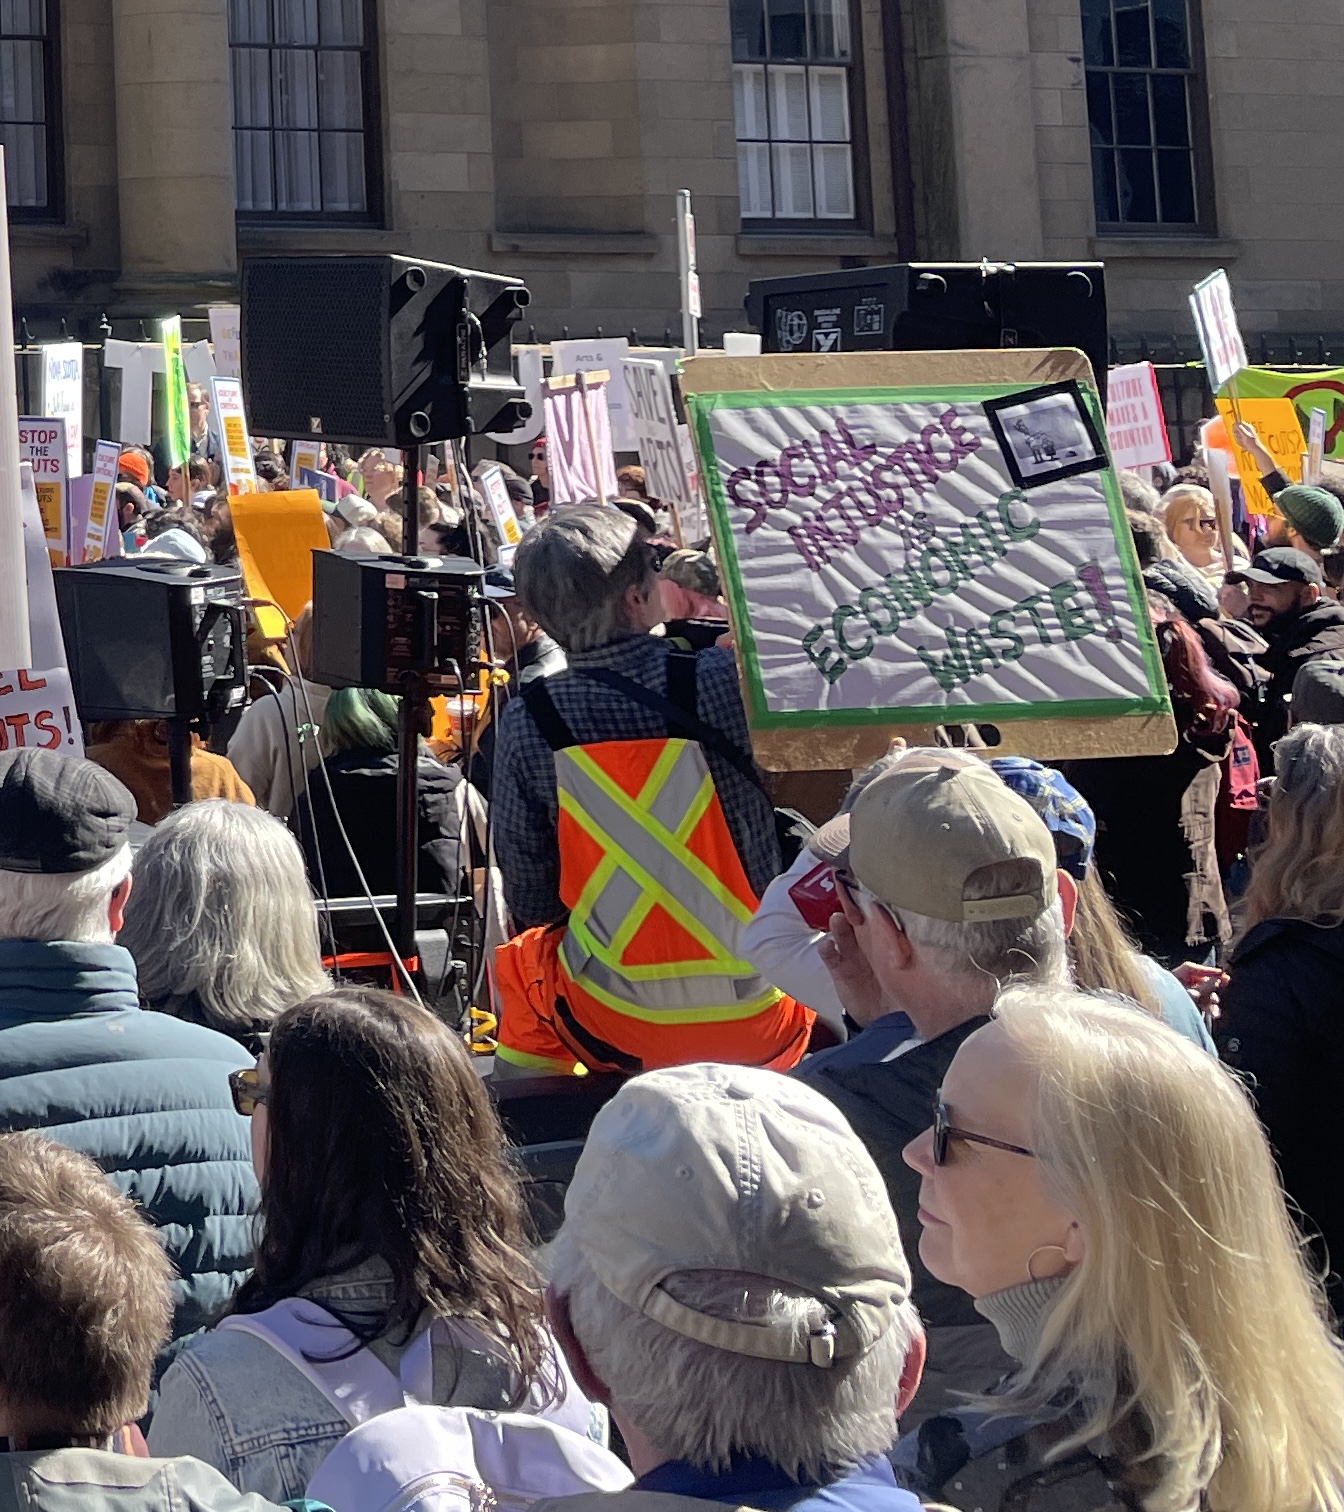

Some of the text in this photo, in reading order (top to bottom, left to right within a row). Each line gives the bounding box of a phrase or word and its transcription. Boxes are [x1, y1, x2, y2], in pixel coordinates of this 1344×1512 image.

[623, 364, 666, 425] SAVE
[1108, 377, 1144, 403] ULTURE
[18, 430, 58, 444] STOP
[29, 445, 49, 456] THE
[32, 458, 60, 473] UTS
[640, 437, 691, 503] ARTS
[727, 417, 877, 535] SOCIAL
[786, 408, 981, 572] INJUSTICE
[898, 511, 936, 554] IS
[802, 488, 1041, 685] ECONOMIC
